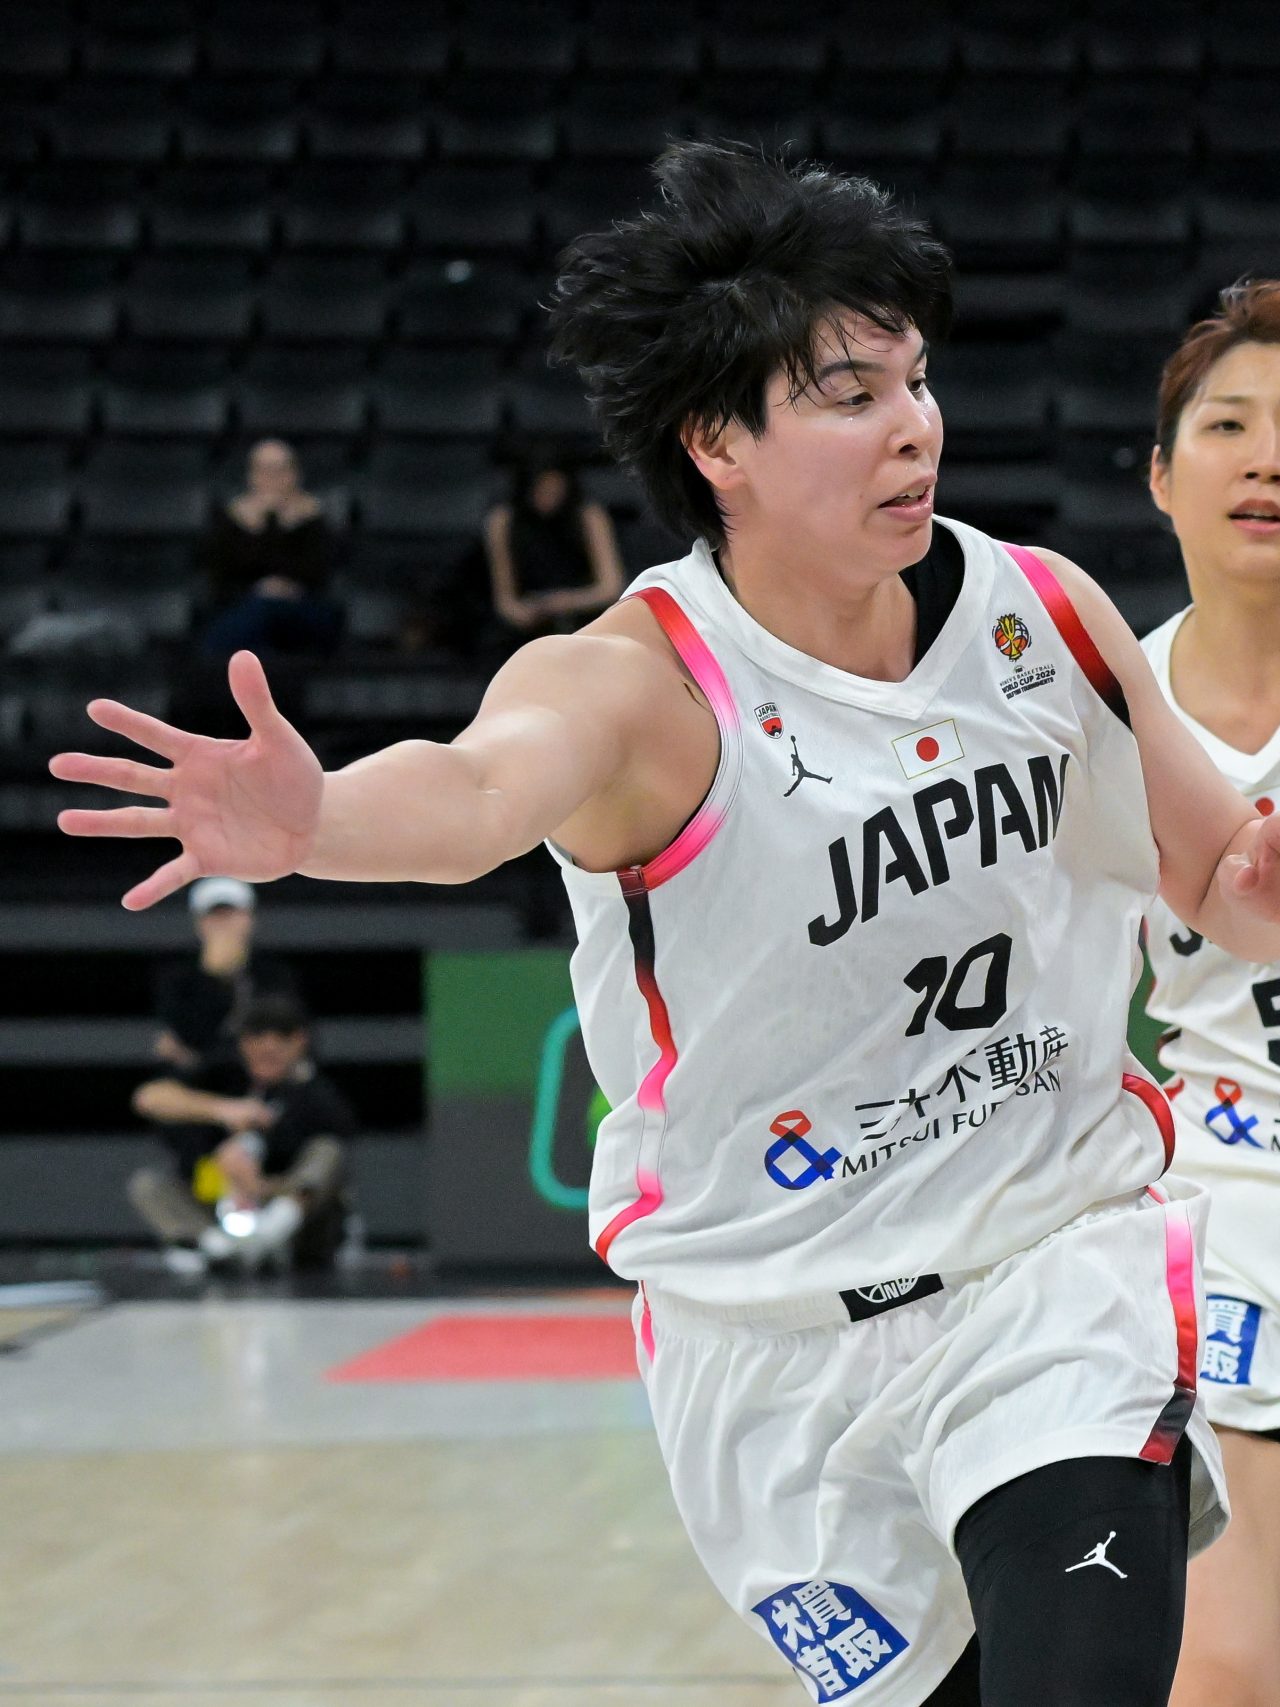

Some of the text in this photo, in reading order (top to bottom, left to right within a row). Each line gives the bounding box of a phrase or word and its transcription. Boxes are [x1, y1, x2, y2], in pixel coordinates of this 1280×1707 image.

[1019, 675, 1035, 686] CUP
[1035, 669, 1056, 681] 2026
[808, 754, 1070, 947] JAPAN
[903, 932, 1013, 1037] 10
